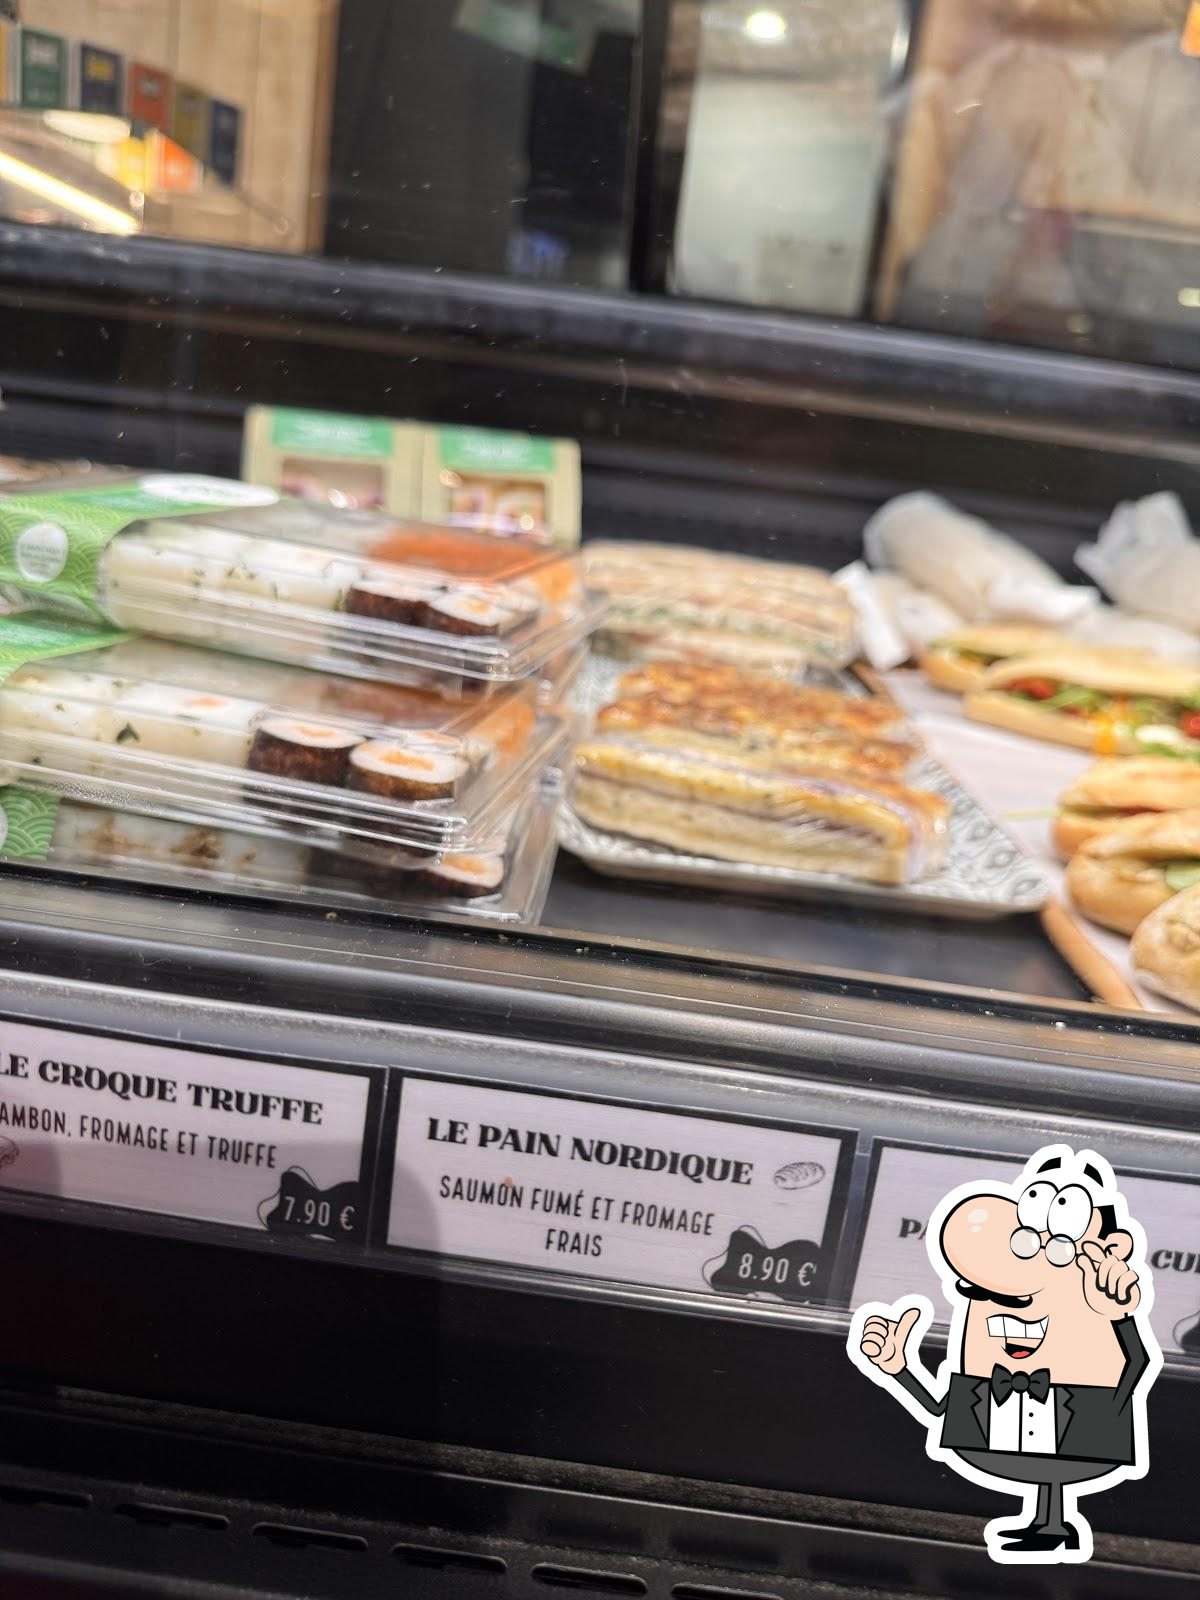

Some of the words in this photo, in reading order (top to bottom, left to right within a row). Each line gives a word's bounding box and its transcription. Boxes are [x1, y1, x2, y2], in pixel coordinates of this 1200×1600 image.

[38, 1060, 177, 1102] CROQUE
[188, 1084, 322, 1124] TRUFFE
[80, 1115, 168, 1152] FROMAGE
[177, 1132, 198, 1156] ET
[208, 1136, 277, 1169] TRUFFE
[428, 1118, 468, 1144] LE
[478, 1124, 560, 1157] PAIN
[570, 1137, 753, 1185] NORDIQUE
[285, 1196, 330, 1226] 7.90
[340, 1206, 355, 1230] €
[440, 1175, 523, 1208] SAUMON
[531, 1188, 584, 1217] FUMÉ
[591, 1197, 615, 1221] ET
[621, 1201, 714, 1235] FROMAGE
[546, 1229, 602, 1256] FRAIS
[898, 1217, 929, 1240] P
[739, 1253, 789, 1283] 8.90
[798, 1262, 816, 1286] €
